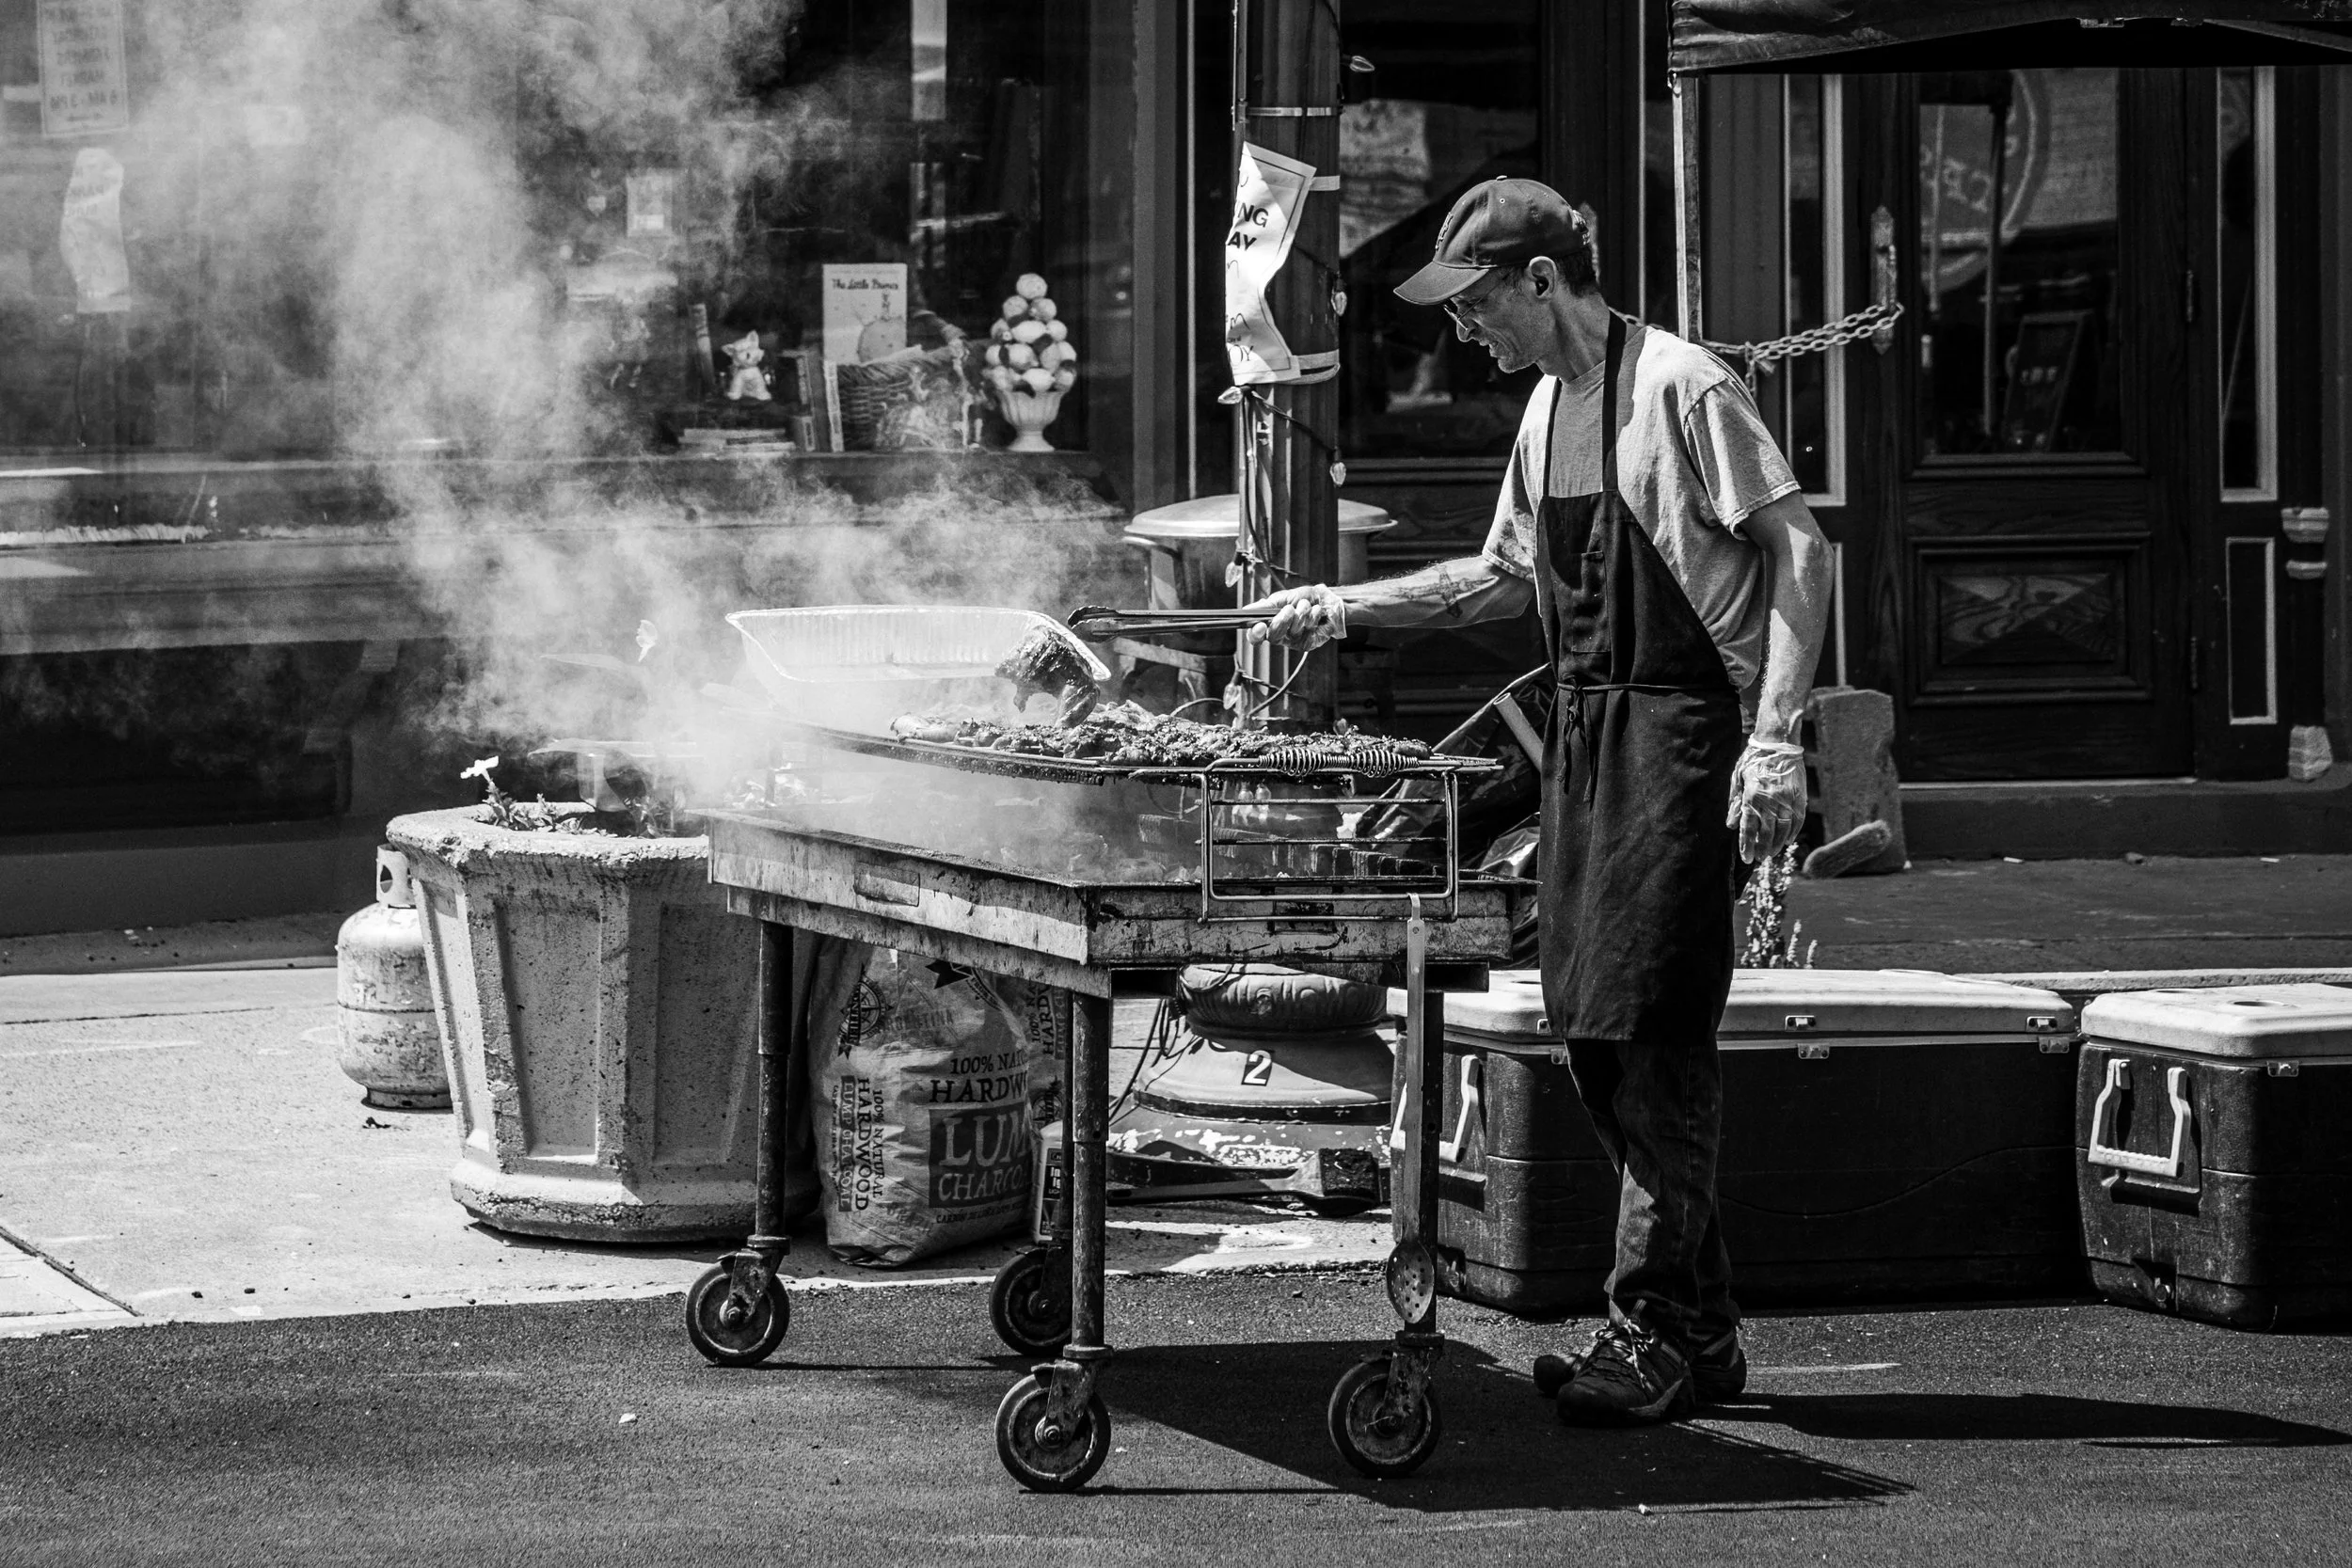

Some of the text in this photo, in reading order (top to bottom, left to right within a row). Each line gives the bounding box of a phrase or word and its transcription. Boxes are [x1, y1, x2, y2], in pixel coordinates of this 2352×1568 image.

[950, 1054, 994, 1075] 100%
[1243, 1049, 1272, 1085] 2
[841, 1083, 854, 1124] LUMP
[854, 1077, 872, 1211] HARDWOOD
[872, 1089, 885, 1198] 100% NATURAL
